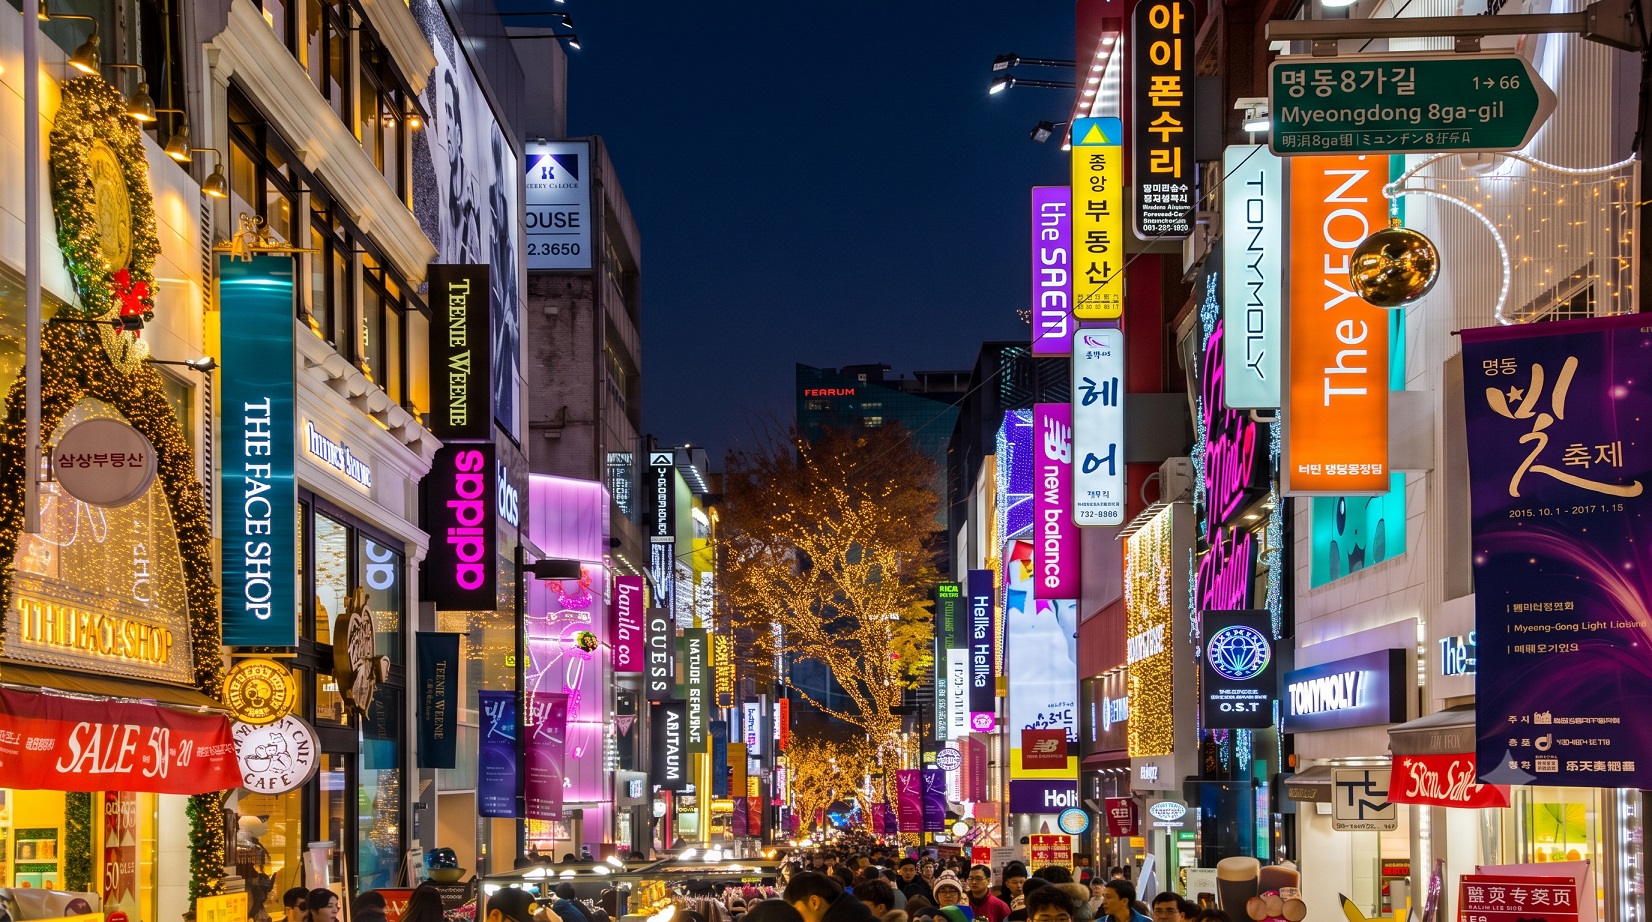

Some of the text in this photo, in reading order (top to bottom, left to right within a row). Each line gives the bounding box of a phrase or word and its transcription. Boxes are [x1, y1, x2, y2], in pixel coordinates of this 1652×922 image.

[1148, 2, 1185, 179] 아이폰수리
[1281, 66, 1416, 97] 명동8가길
[1280, 100, 1504, 126] Myeongdong 8ga-gil
[1041, 202, 1067, 241] the
[1247, 171, 1265, 380] TONYMOLY
[448, 278, 471, 427] TEENIE WEENIE
[1324, 318, 1368, 407] The
[1482, 357, 1518, 376] 명동
[1561, 440, 1624, 469] 축제
[1043, 465, 1060, 506] new
[244, 396, 272, 621] THE FACE SHOP
[447, 450, 486, 591] adidas
[1572, 504, 1597, 515] 2017
[1043, 508, 1063, 588] balance
[618, 583, 640, 641] banila
[1582, 621, 1607, 632] Light
[651, 618, 668, 692] GUESS
[1439, 636, 1467, 676] The
[1219, 702, 1260, 712] O.S.T
[55, 721, 141, 774] SALE
[176, 739, 194, 767] 20
[244, 772, 292, 790] CAFE
